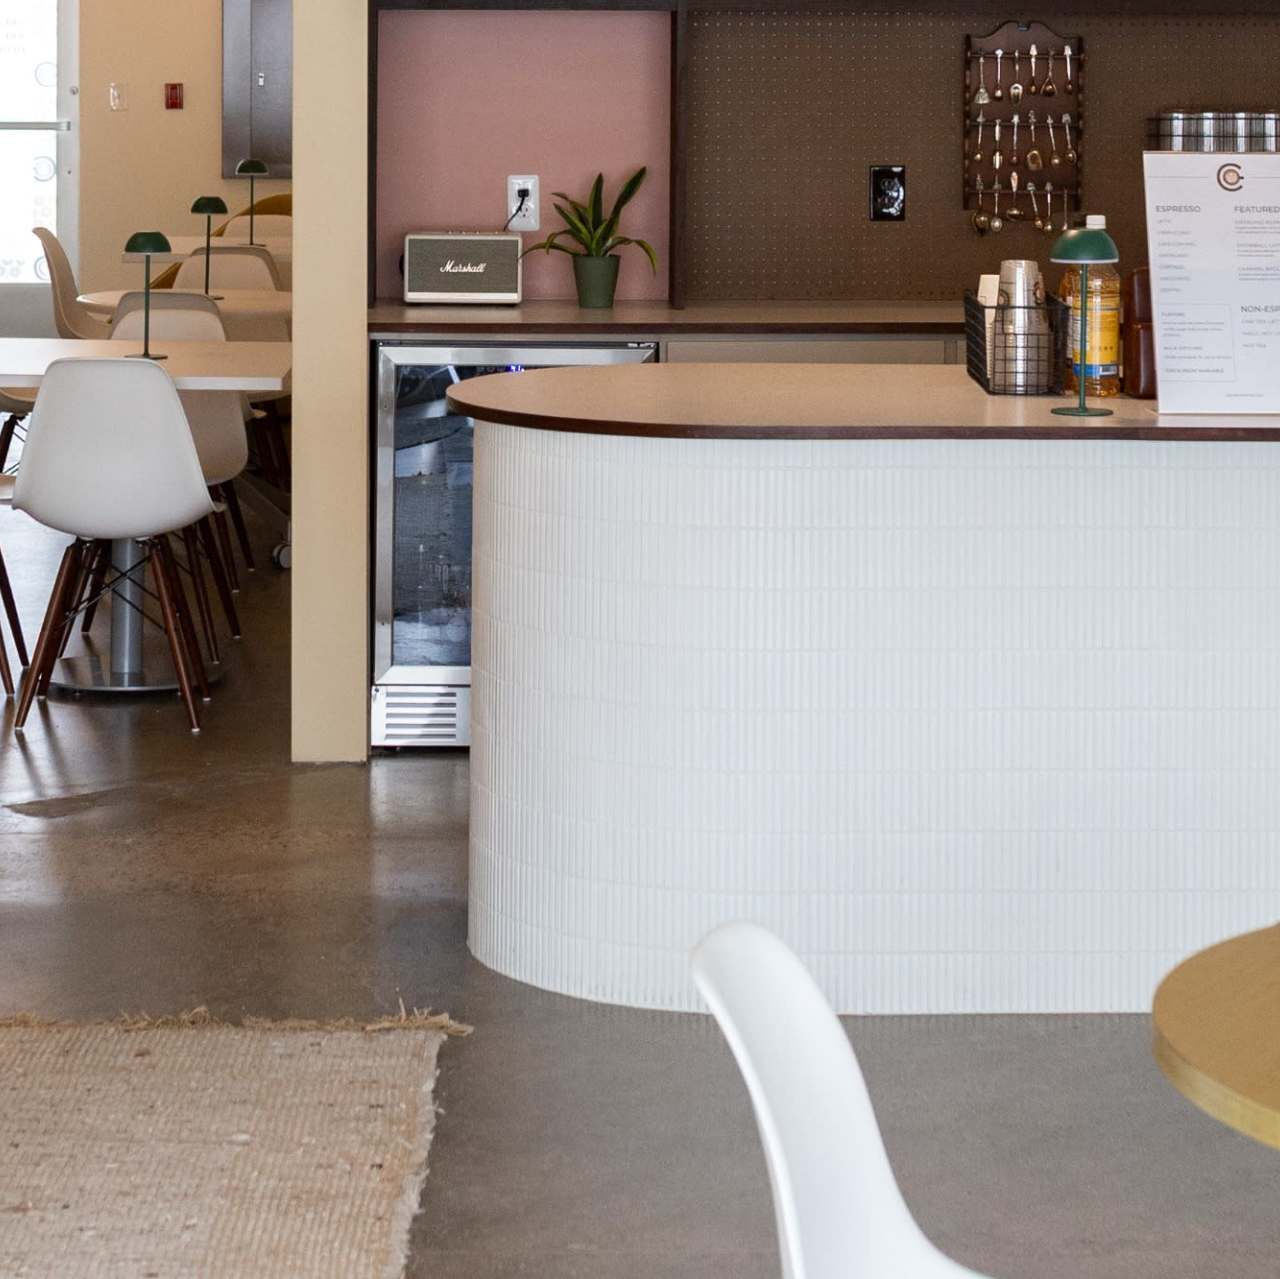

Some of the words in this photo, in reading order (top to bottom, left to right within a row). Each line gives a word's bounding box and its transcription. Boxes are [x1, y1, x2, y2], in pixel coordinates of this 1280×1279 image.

[1155, 205, 1201, 213] ESPRESSO
[1233, 205, 1280, 213] FEATURED
[439, 259, 487, 273] Marshall
